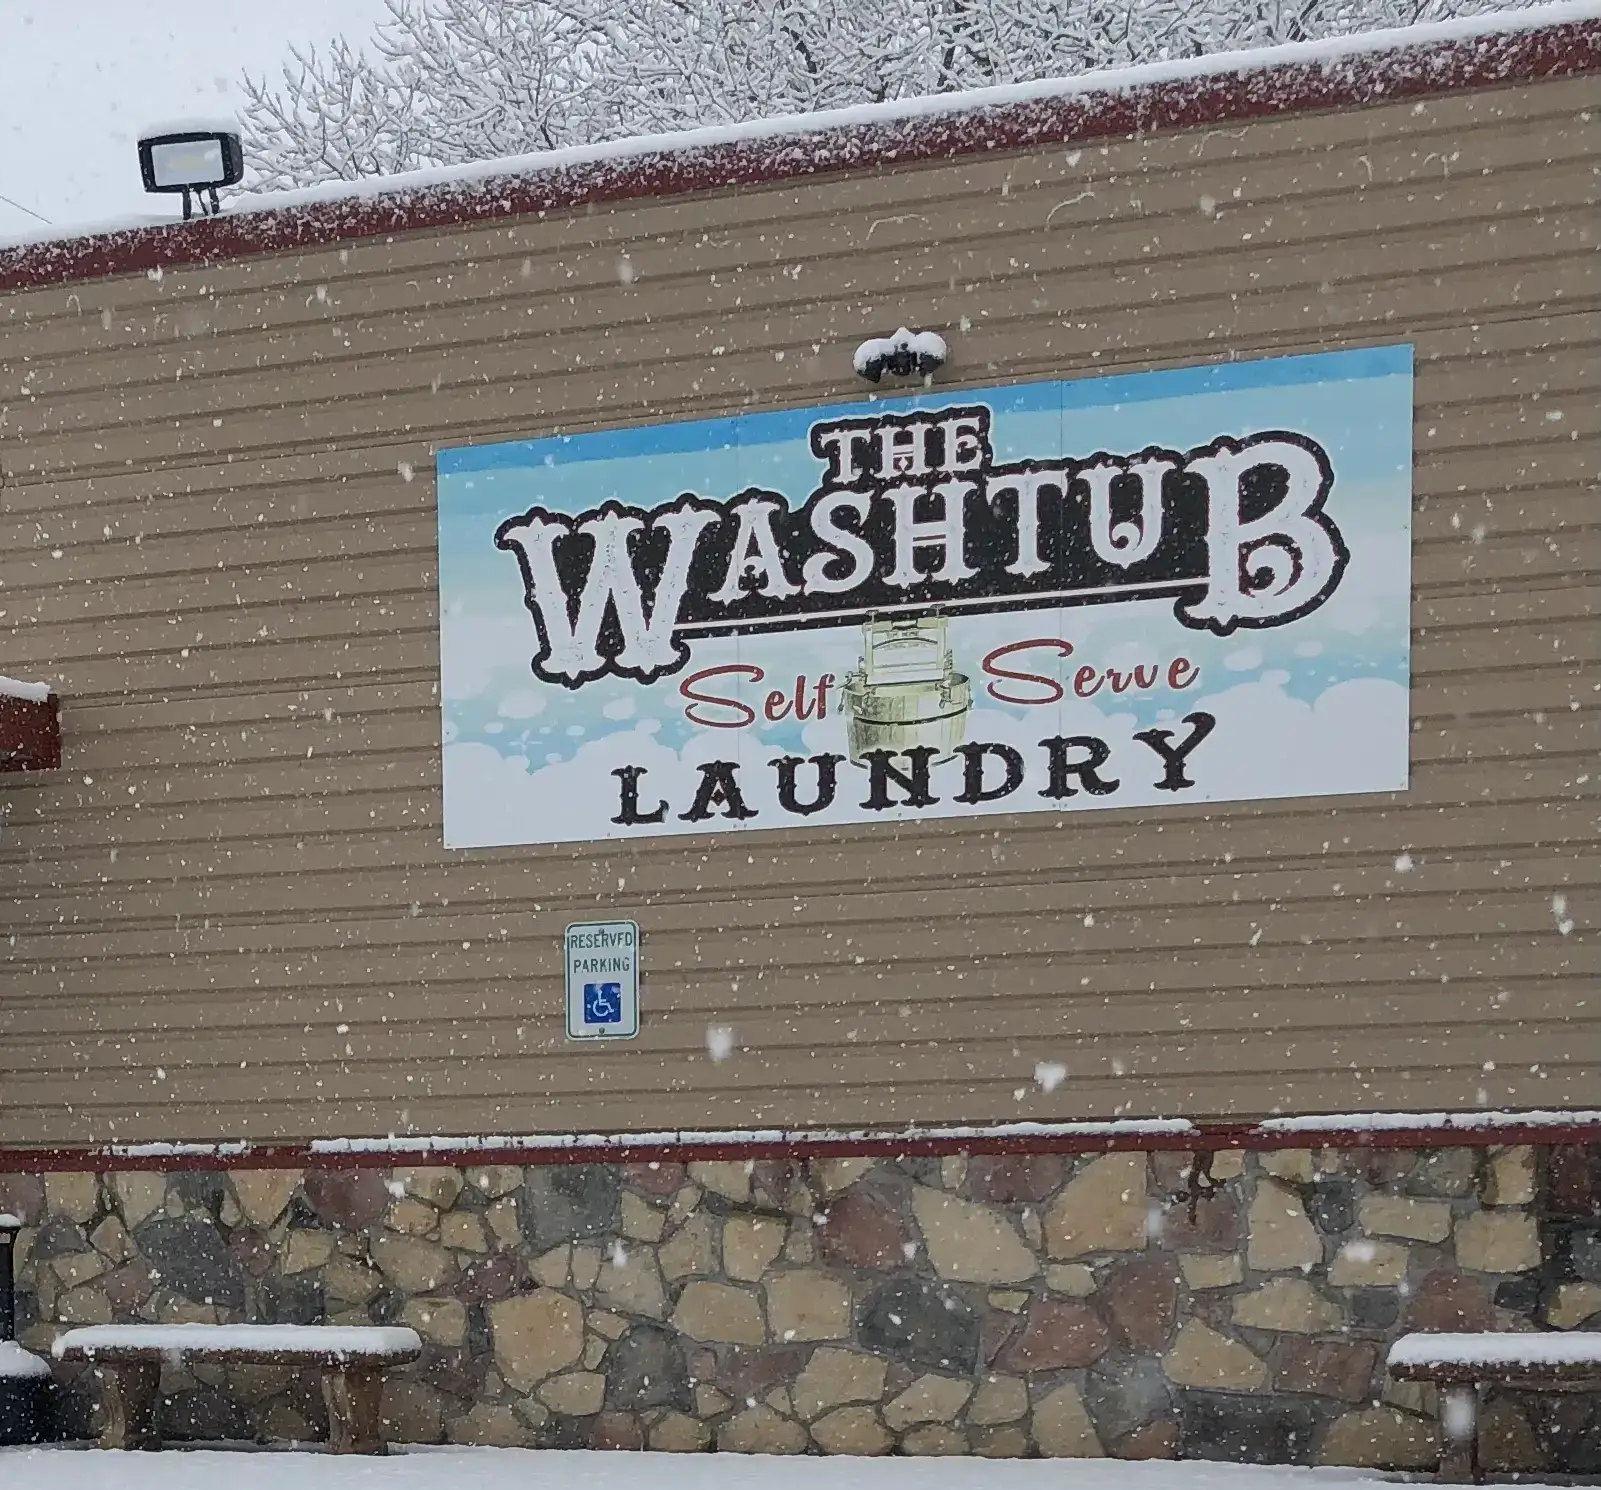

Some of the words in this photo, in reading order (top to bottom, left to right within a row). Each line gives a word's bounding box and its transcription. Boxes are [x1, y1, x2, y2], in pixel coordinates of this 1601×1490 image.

[818, 416, 986, 484] THE
[500, 438, 1344, 684] WASHTUB
[679, 663, 837, 729] Self
[981, 637, 1201, 706] Serve
[610, 711, 1216, 827] LAUNDRY
[573, 956, 631, 974] PARKING
